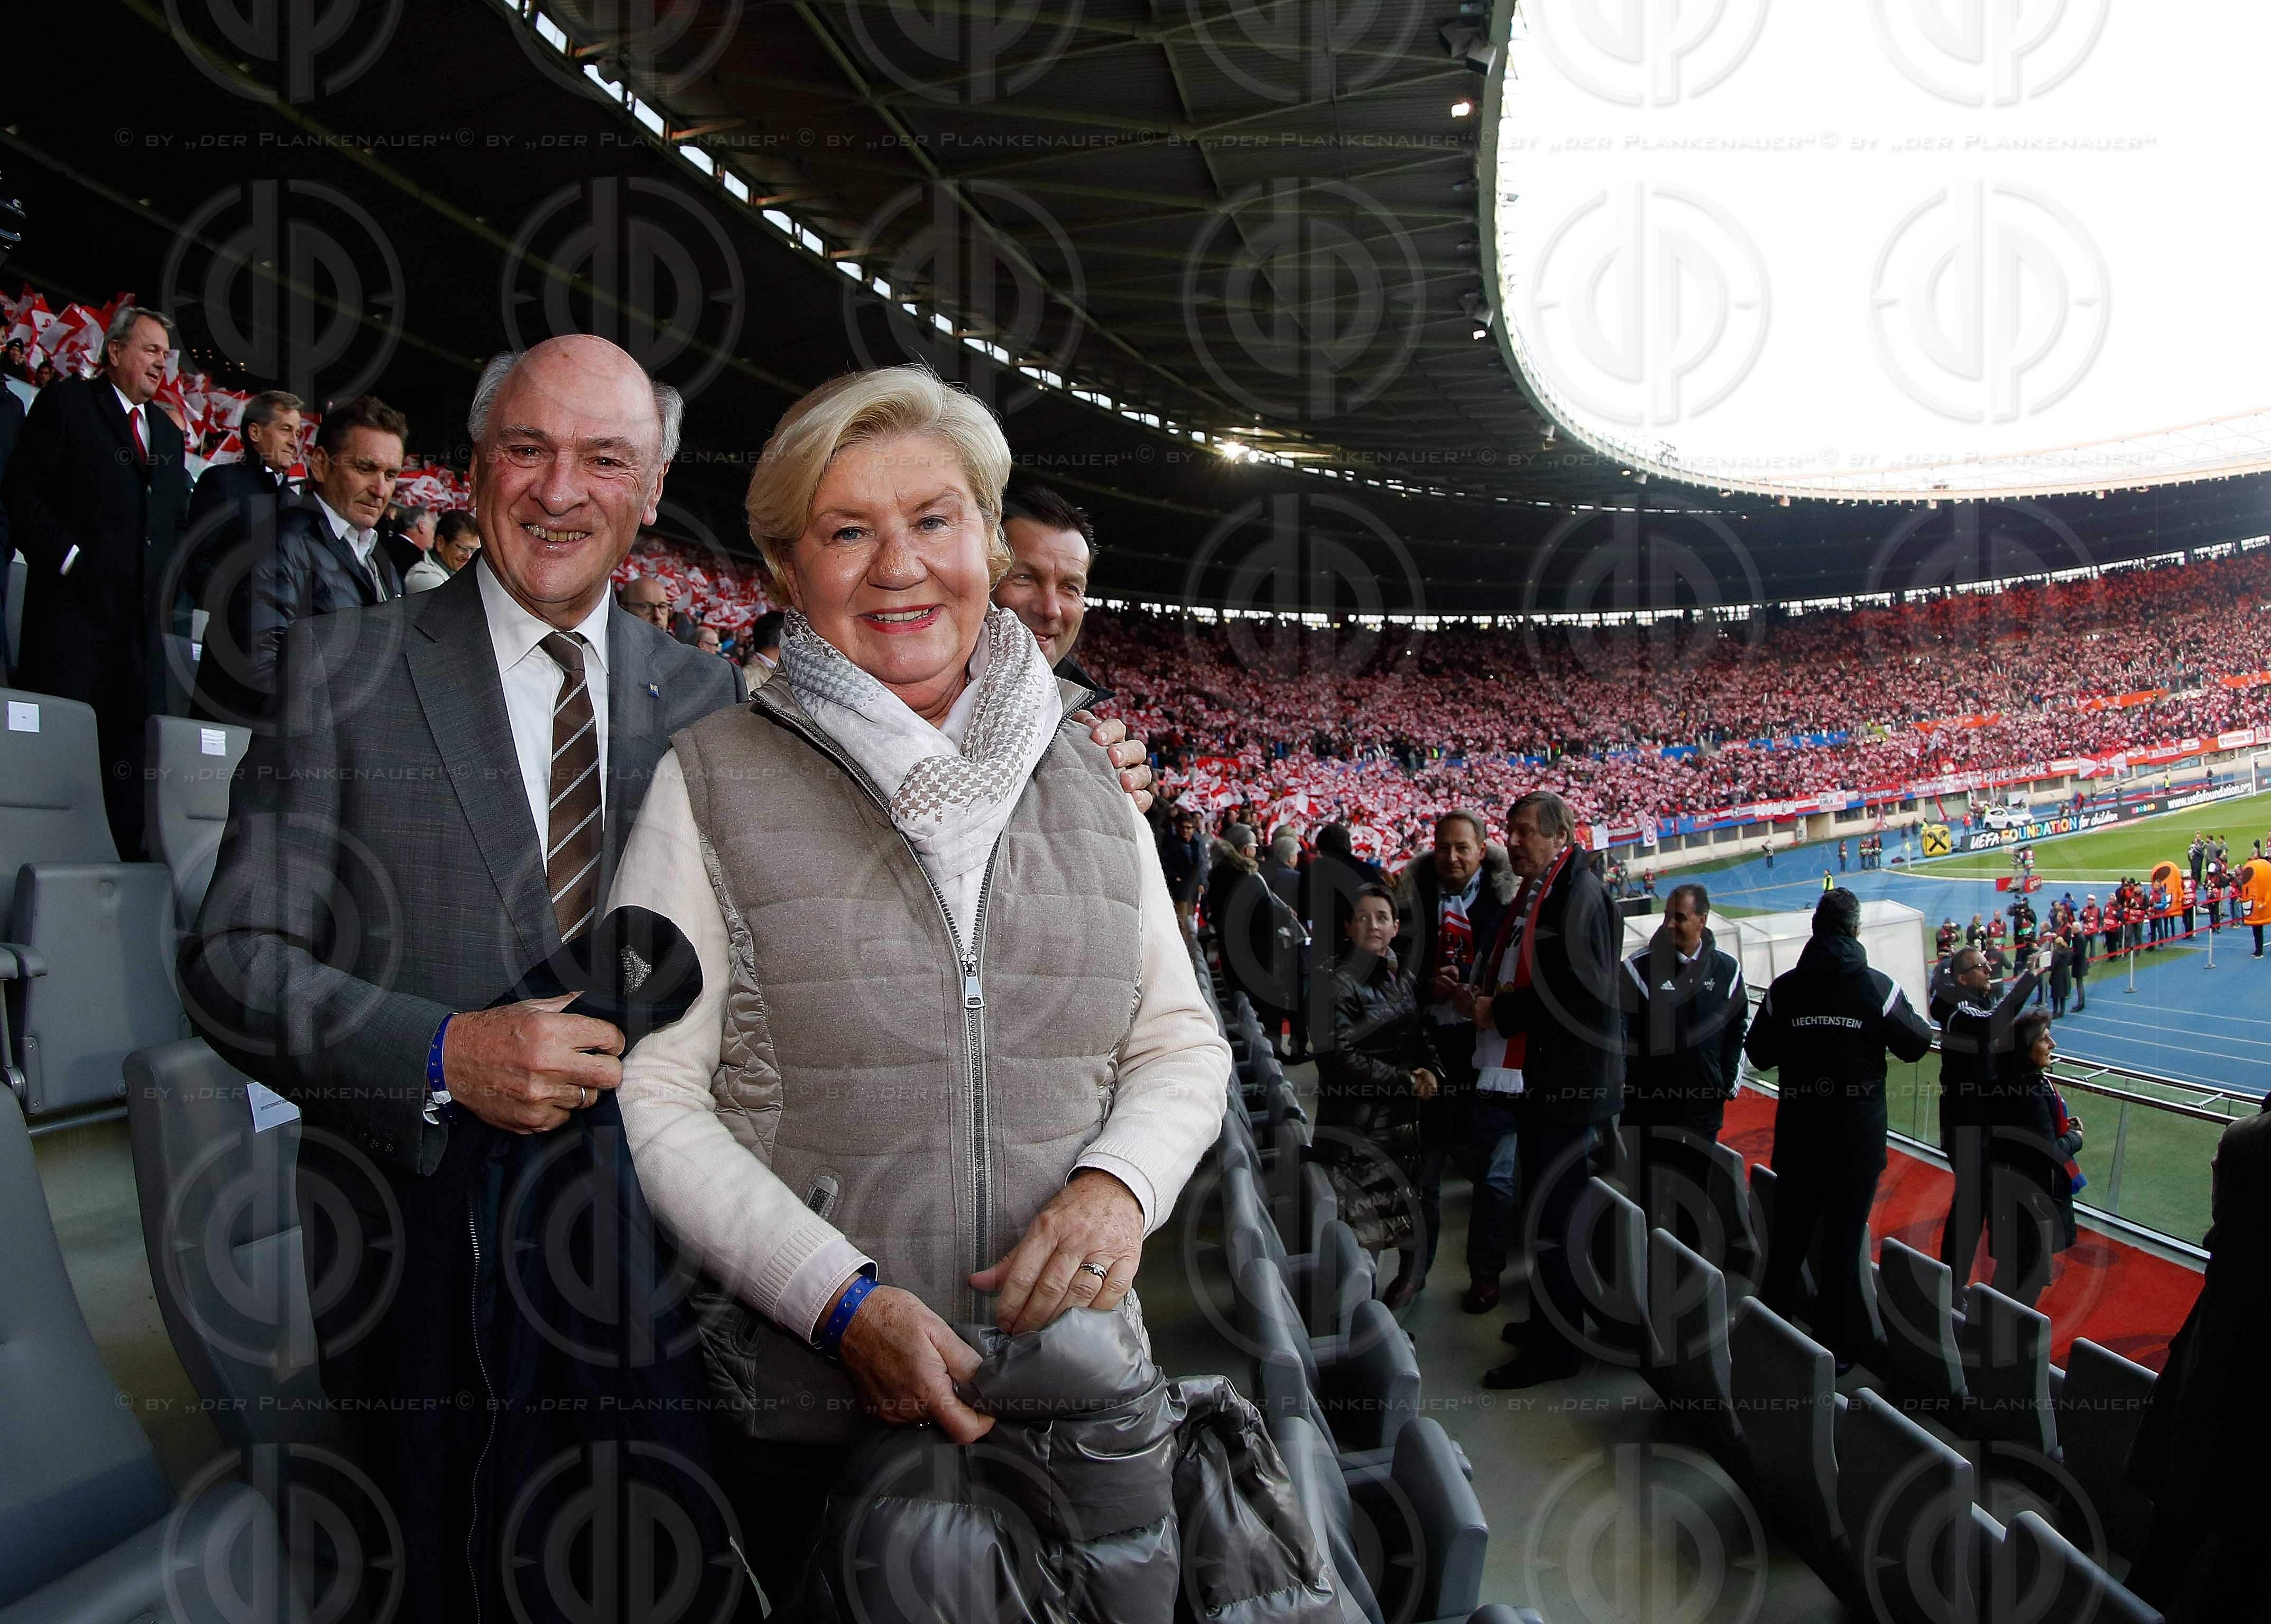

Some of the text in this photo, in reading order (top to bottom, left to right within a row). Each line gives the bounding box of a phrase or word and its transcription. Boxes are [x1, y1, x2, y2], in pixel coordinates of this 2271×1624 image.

[2167, 782, 2252, 809] www.uefafoundation.org
[1970, 832, 2000, 849] UEFA
[2079, 815, 2091, 830] for
[2091, 810, 2118, 826] children
[1792, 1016, 1862, 1029] LIECHTENSTEIN
